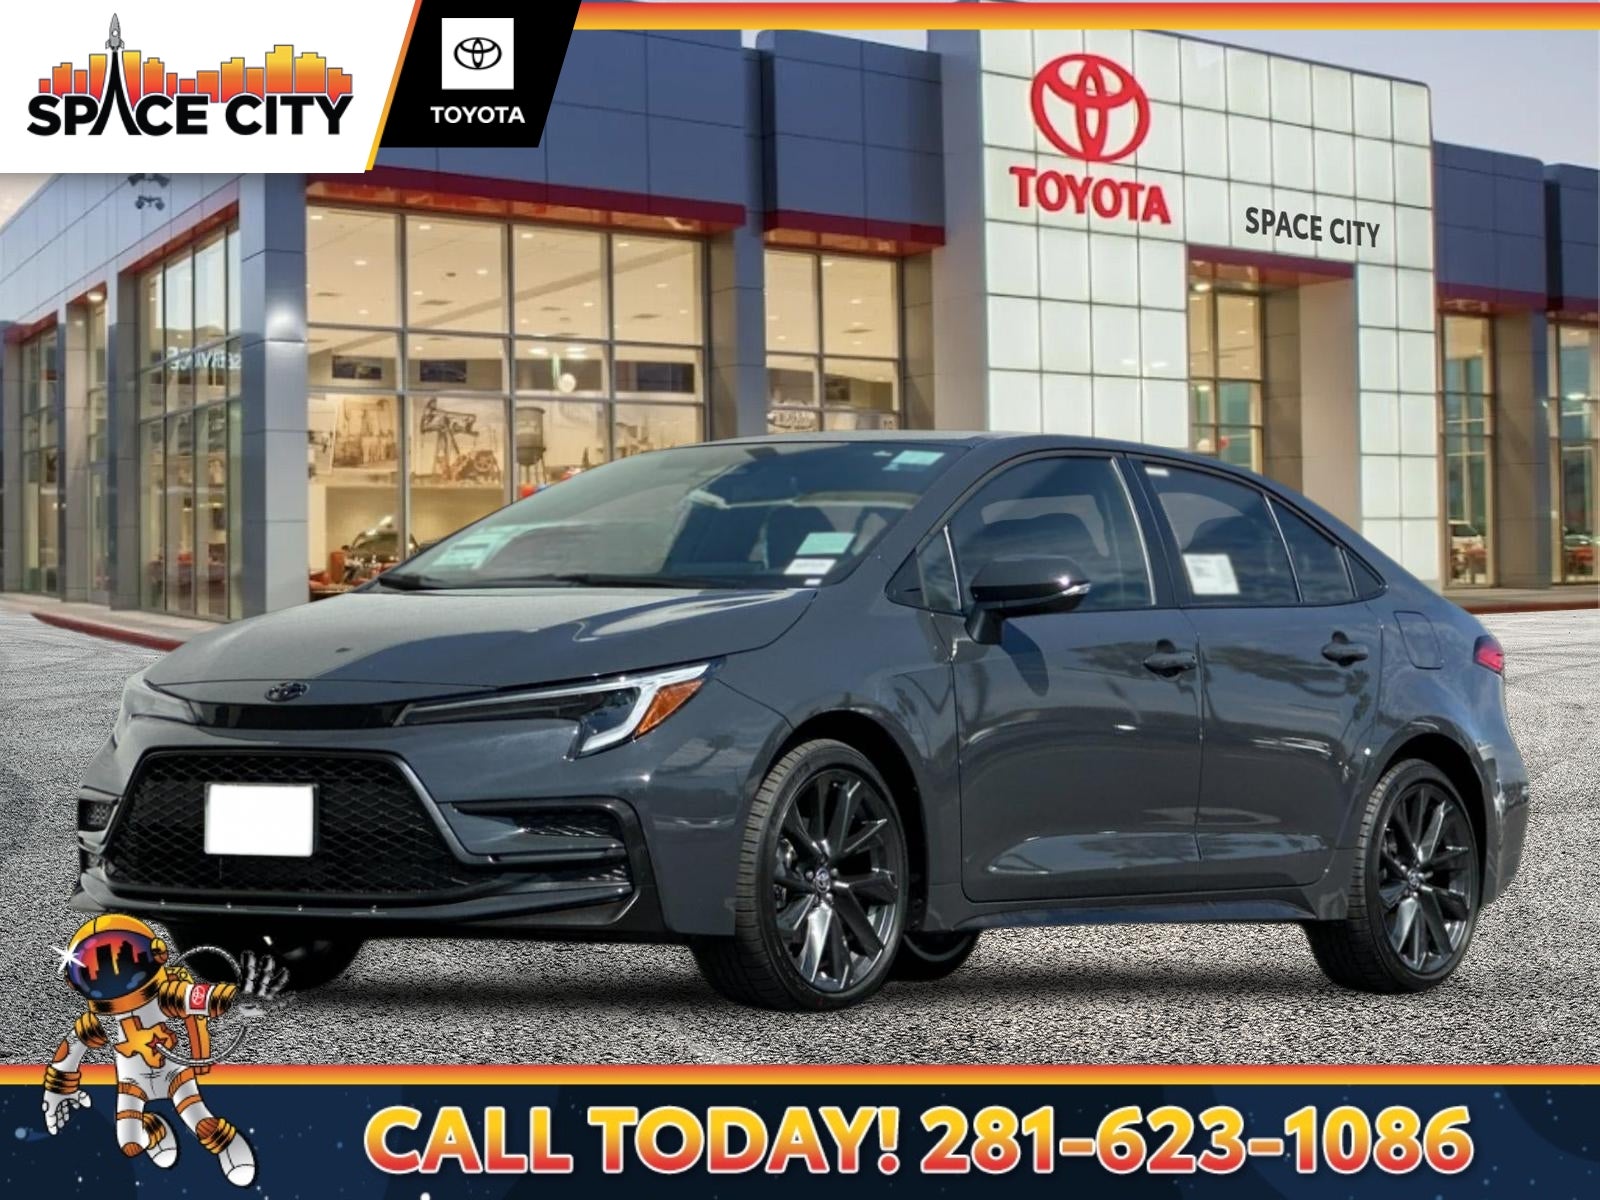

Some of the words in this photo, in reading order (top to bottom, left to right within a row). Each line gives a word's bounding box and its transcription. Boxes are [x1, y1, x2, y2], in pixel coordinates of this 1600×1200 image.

[1009, 165, 1172, 224] TOYOTA
[1244, 206, 1322, 242] SPACE
[1329, 218, 1381, 248] CITY
